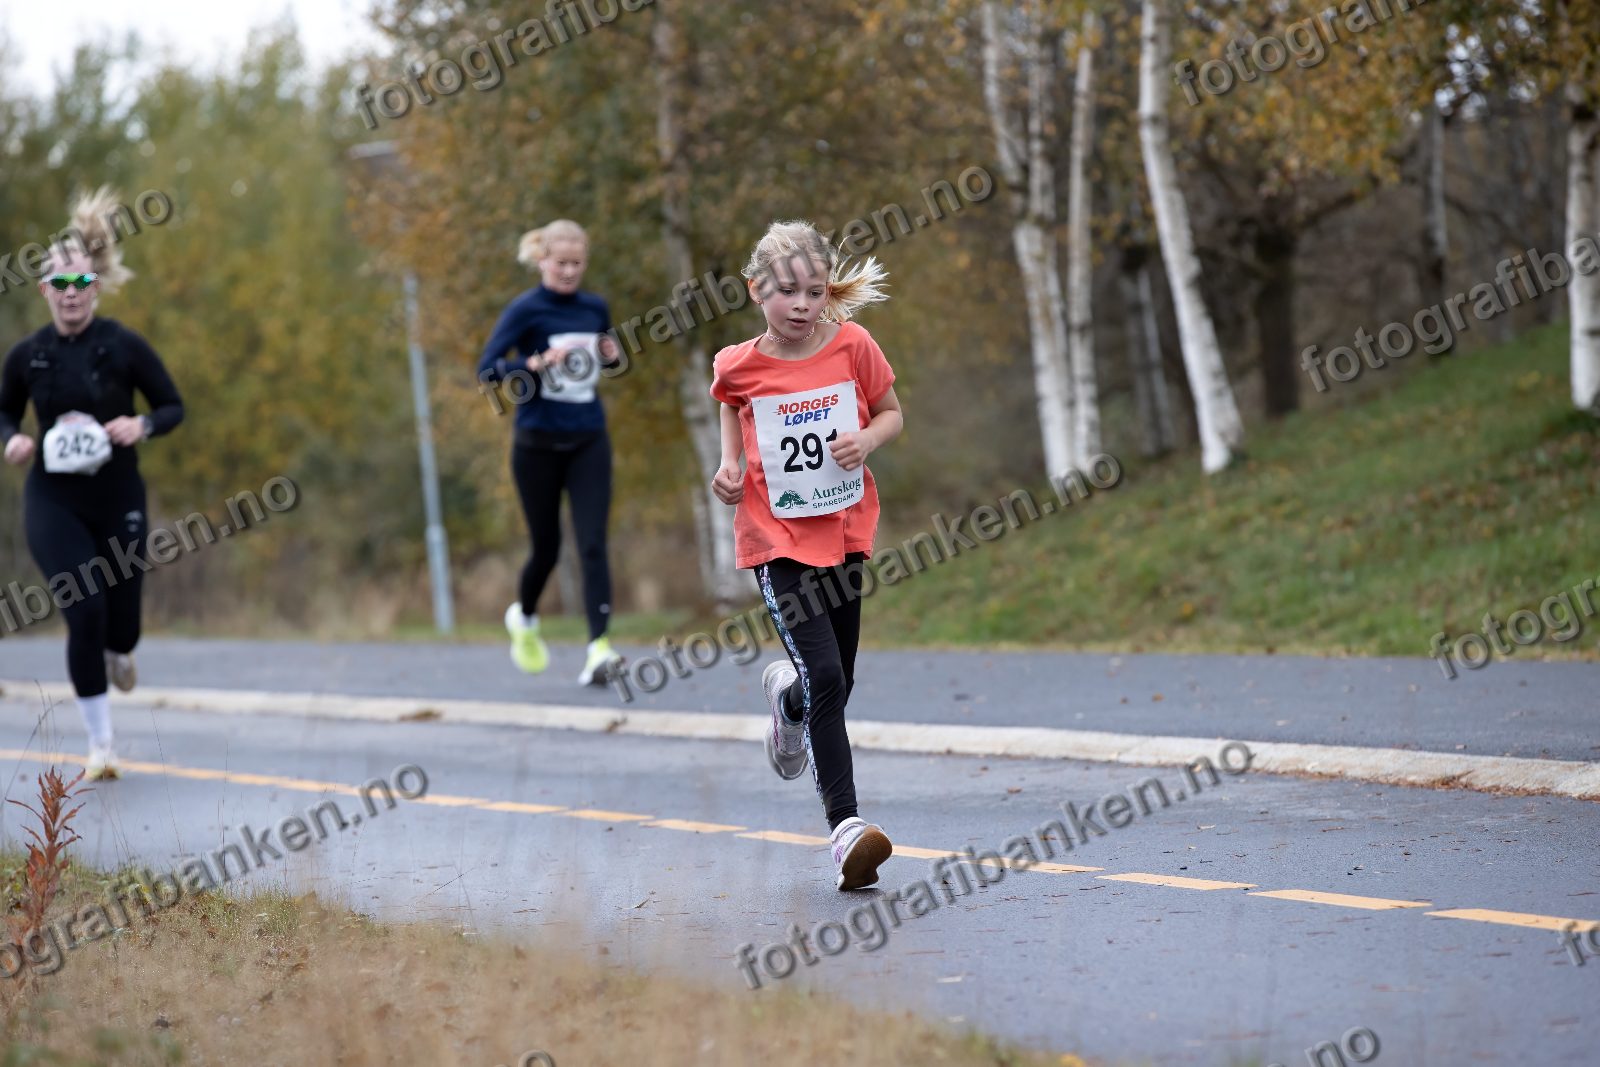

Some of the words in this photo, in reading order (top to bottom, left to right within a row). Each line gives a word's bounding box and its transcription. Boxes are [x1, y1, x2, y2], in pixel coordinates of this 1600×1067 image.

[777, 394, 839, 415] NORGES
[784, 408, 831, 426] LØPET
[56, 432, 96, 458] 242
[812, 477, 861, 500] Aurskog
